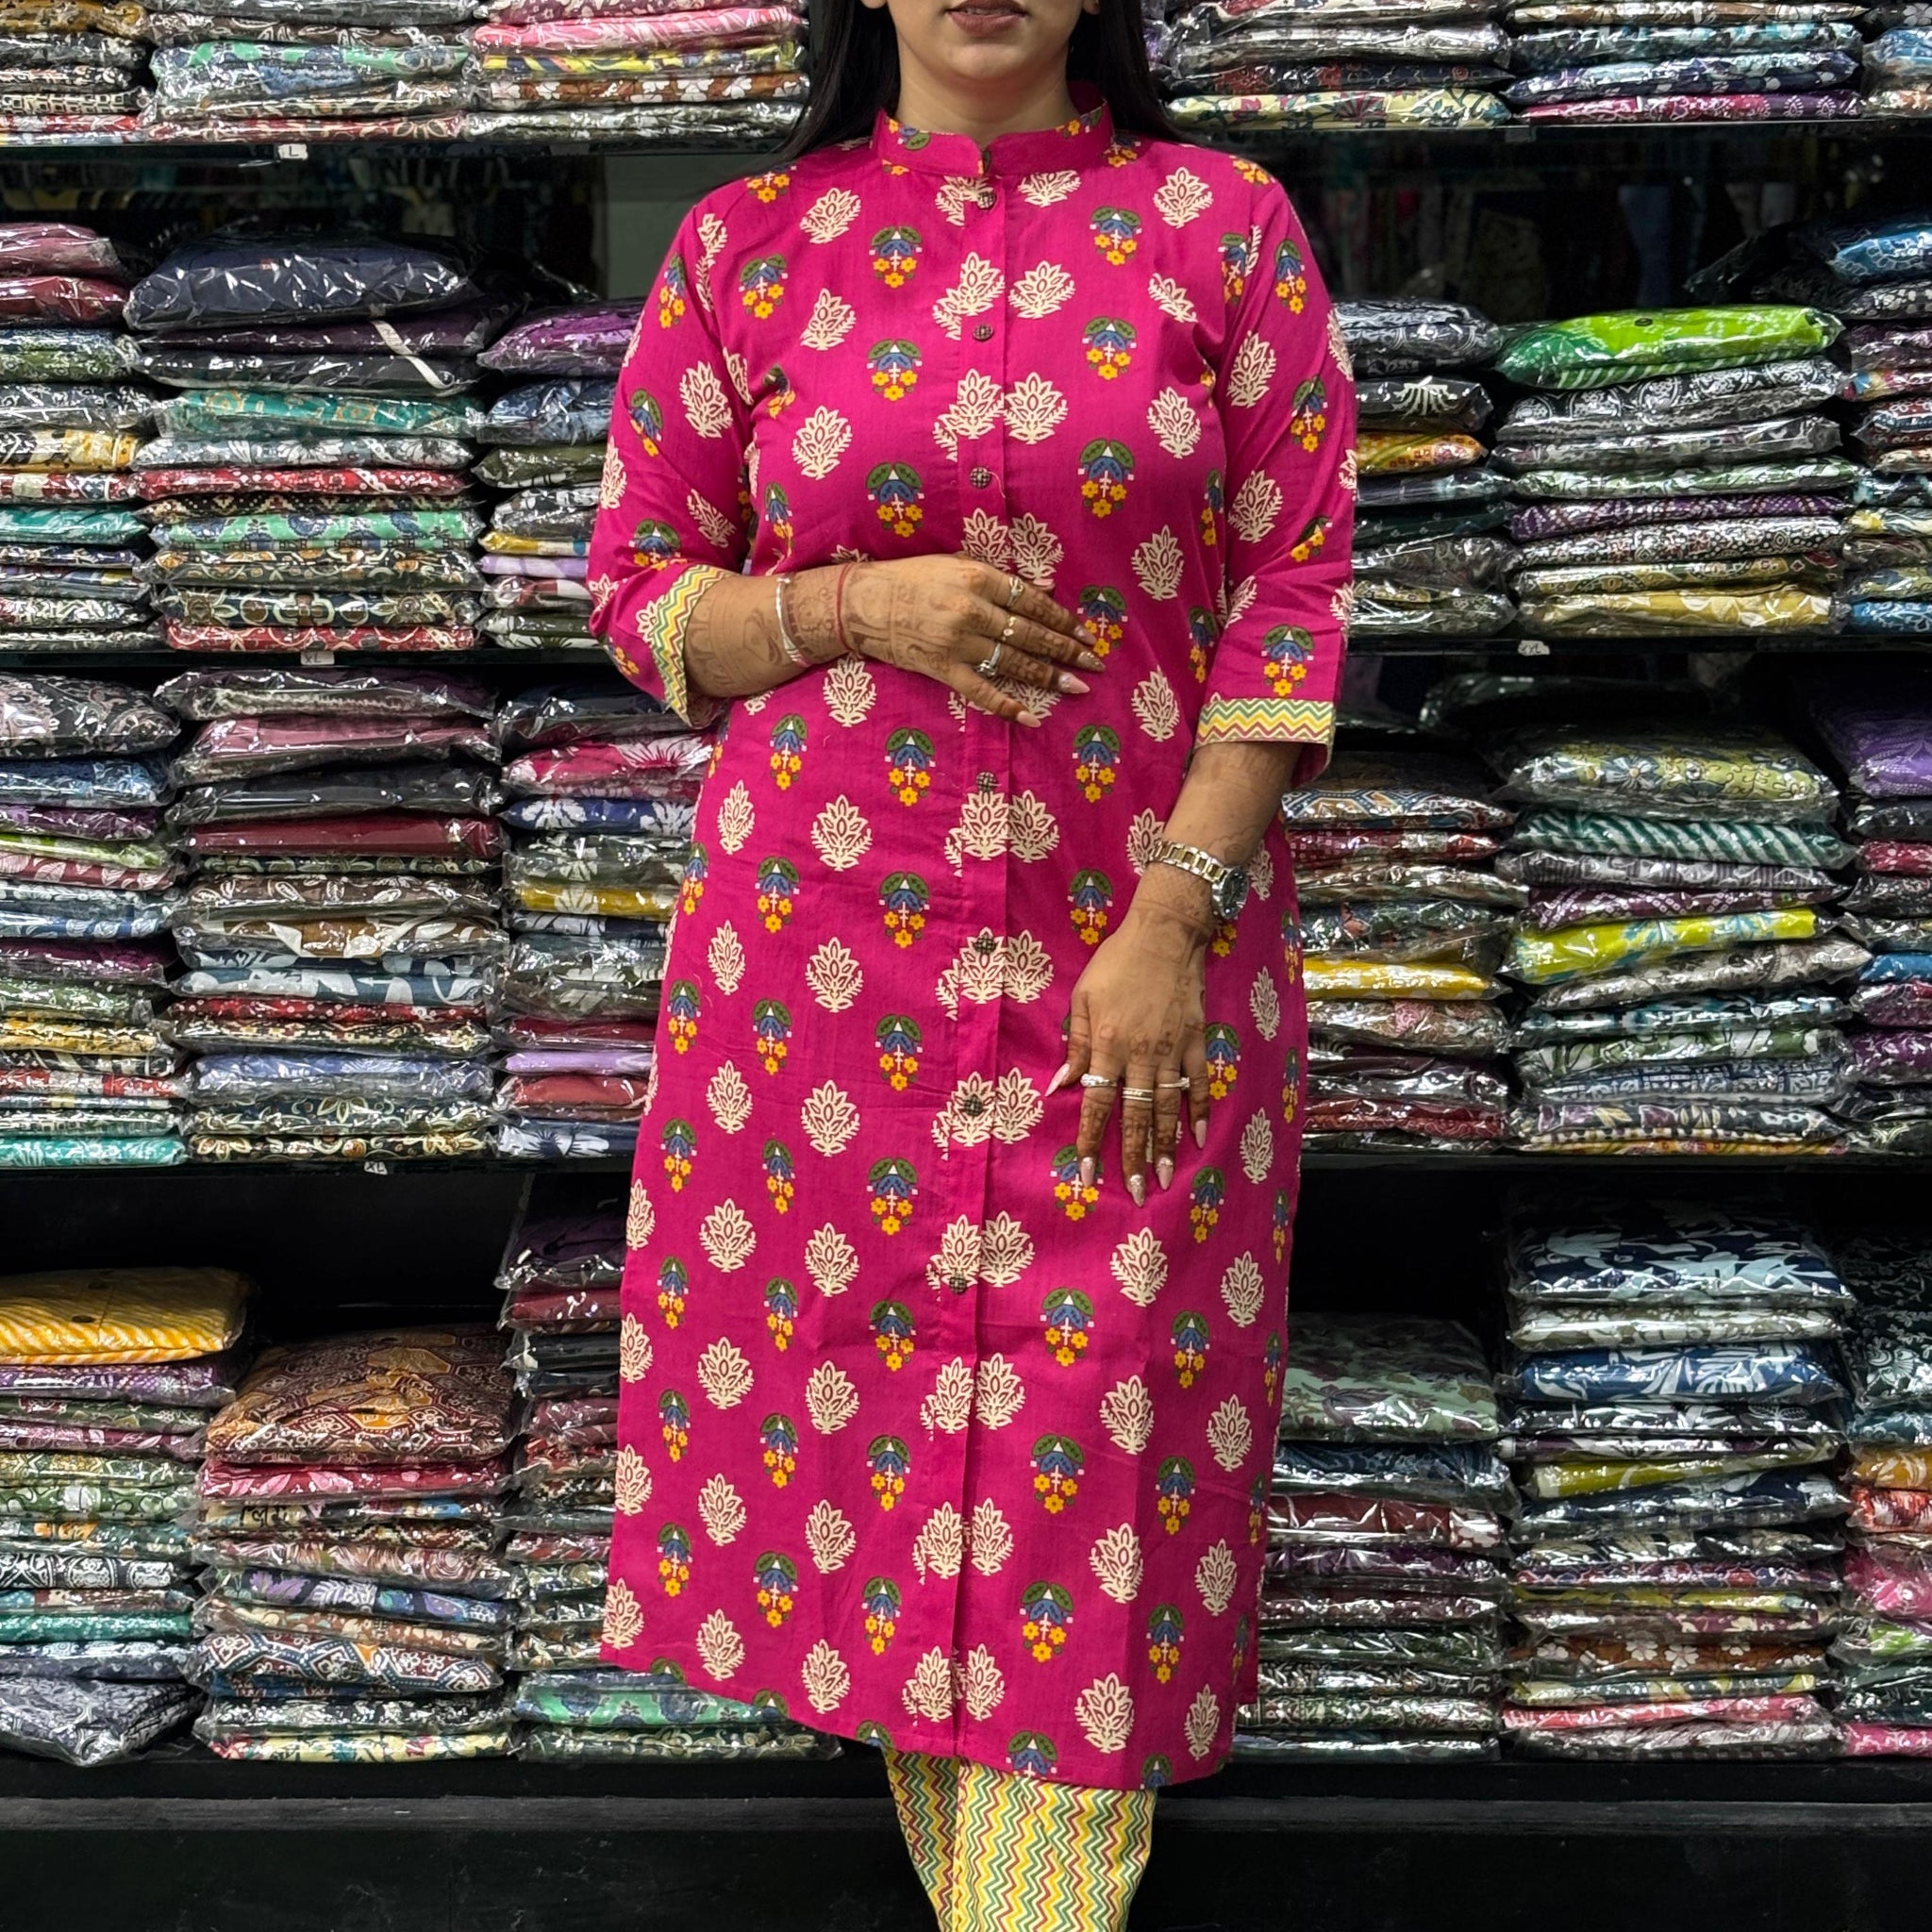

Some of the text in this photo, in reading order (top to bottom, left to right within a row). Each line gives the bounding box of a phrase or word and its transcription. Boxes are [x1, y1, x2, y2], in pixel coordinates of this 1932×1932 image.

[289, 145, 299, 157] L
[304, 652, 322, 664] XL
[366, 1161, 385, 1173] XL
